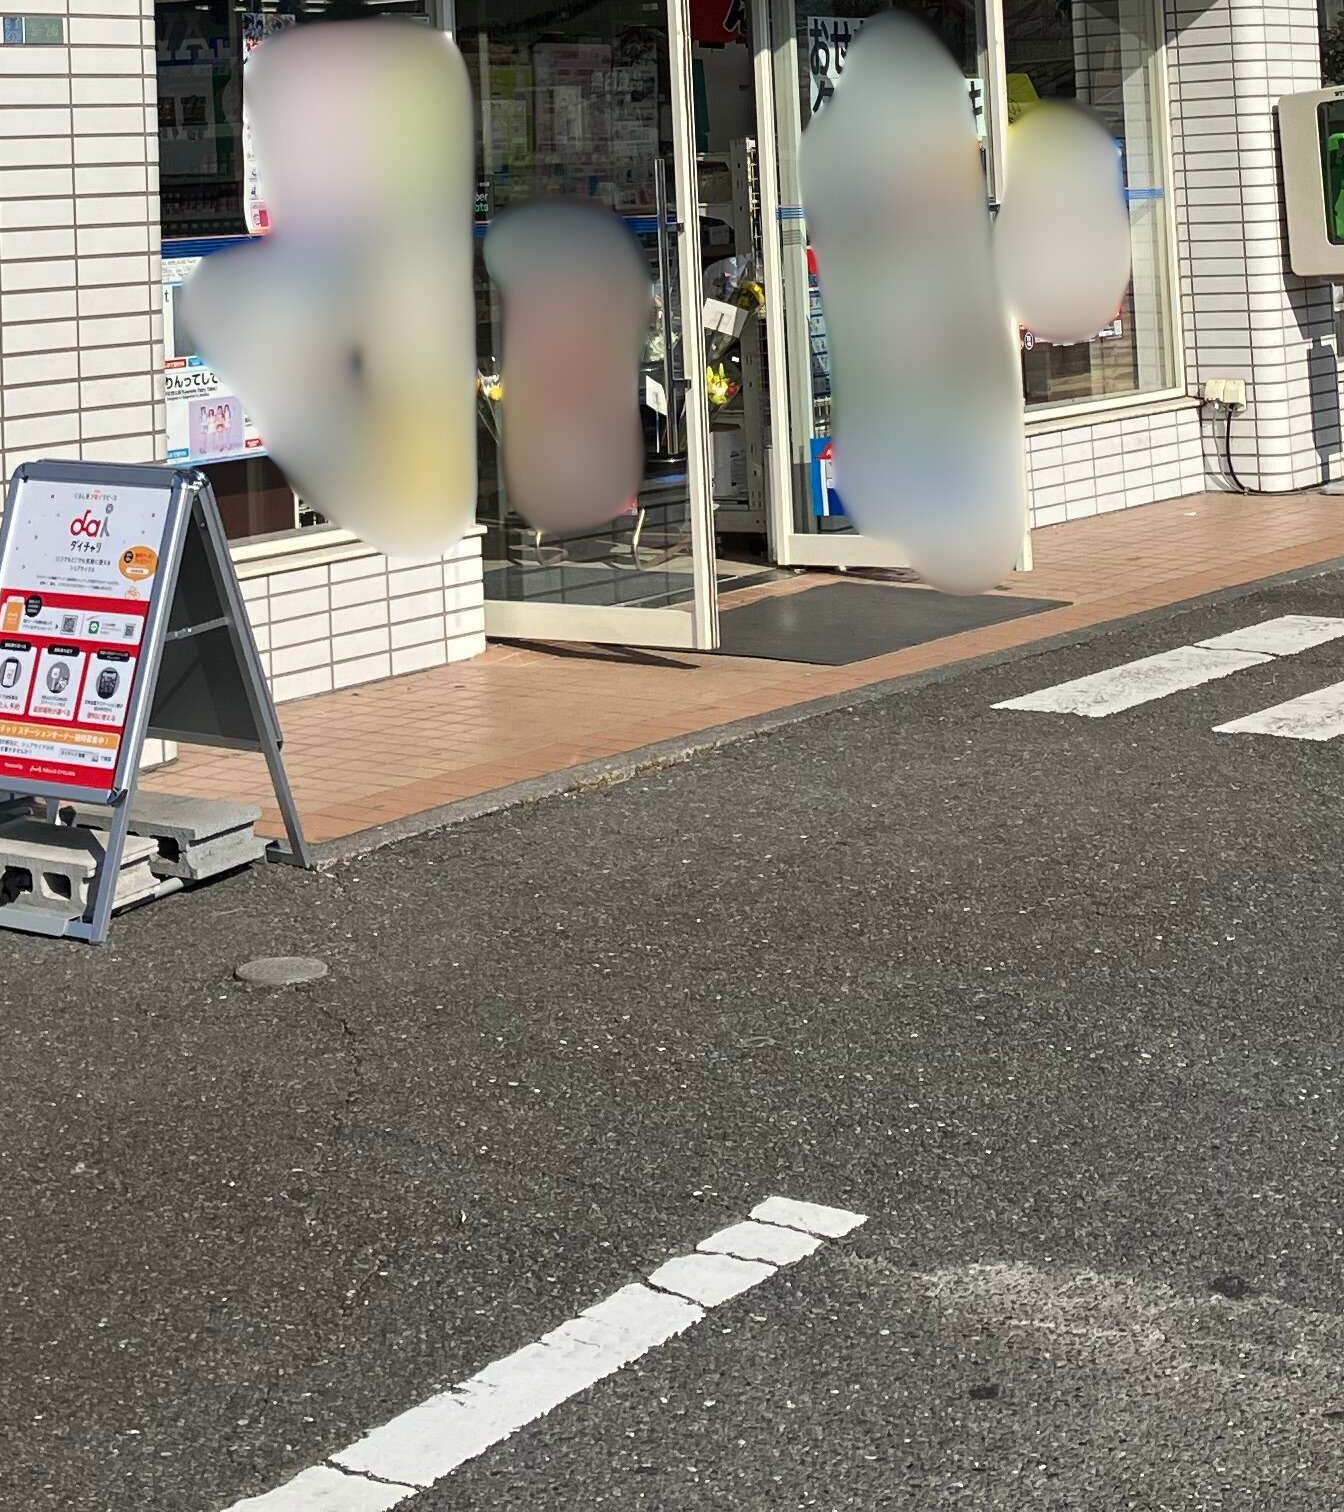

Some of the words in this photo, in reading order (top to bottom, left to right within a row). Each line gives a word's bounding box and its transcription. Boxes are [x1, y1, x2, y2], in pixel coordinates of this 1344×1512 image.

[70, 540, 102, 553] ダイチャリ
